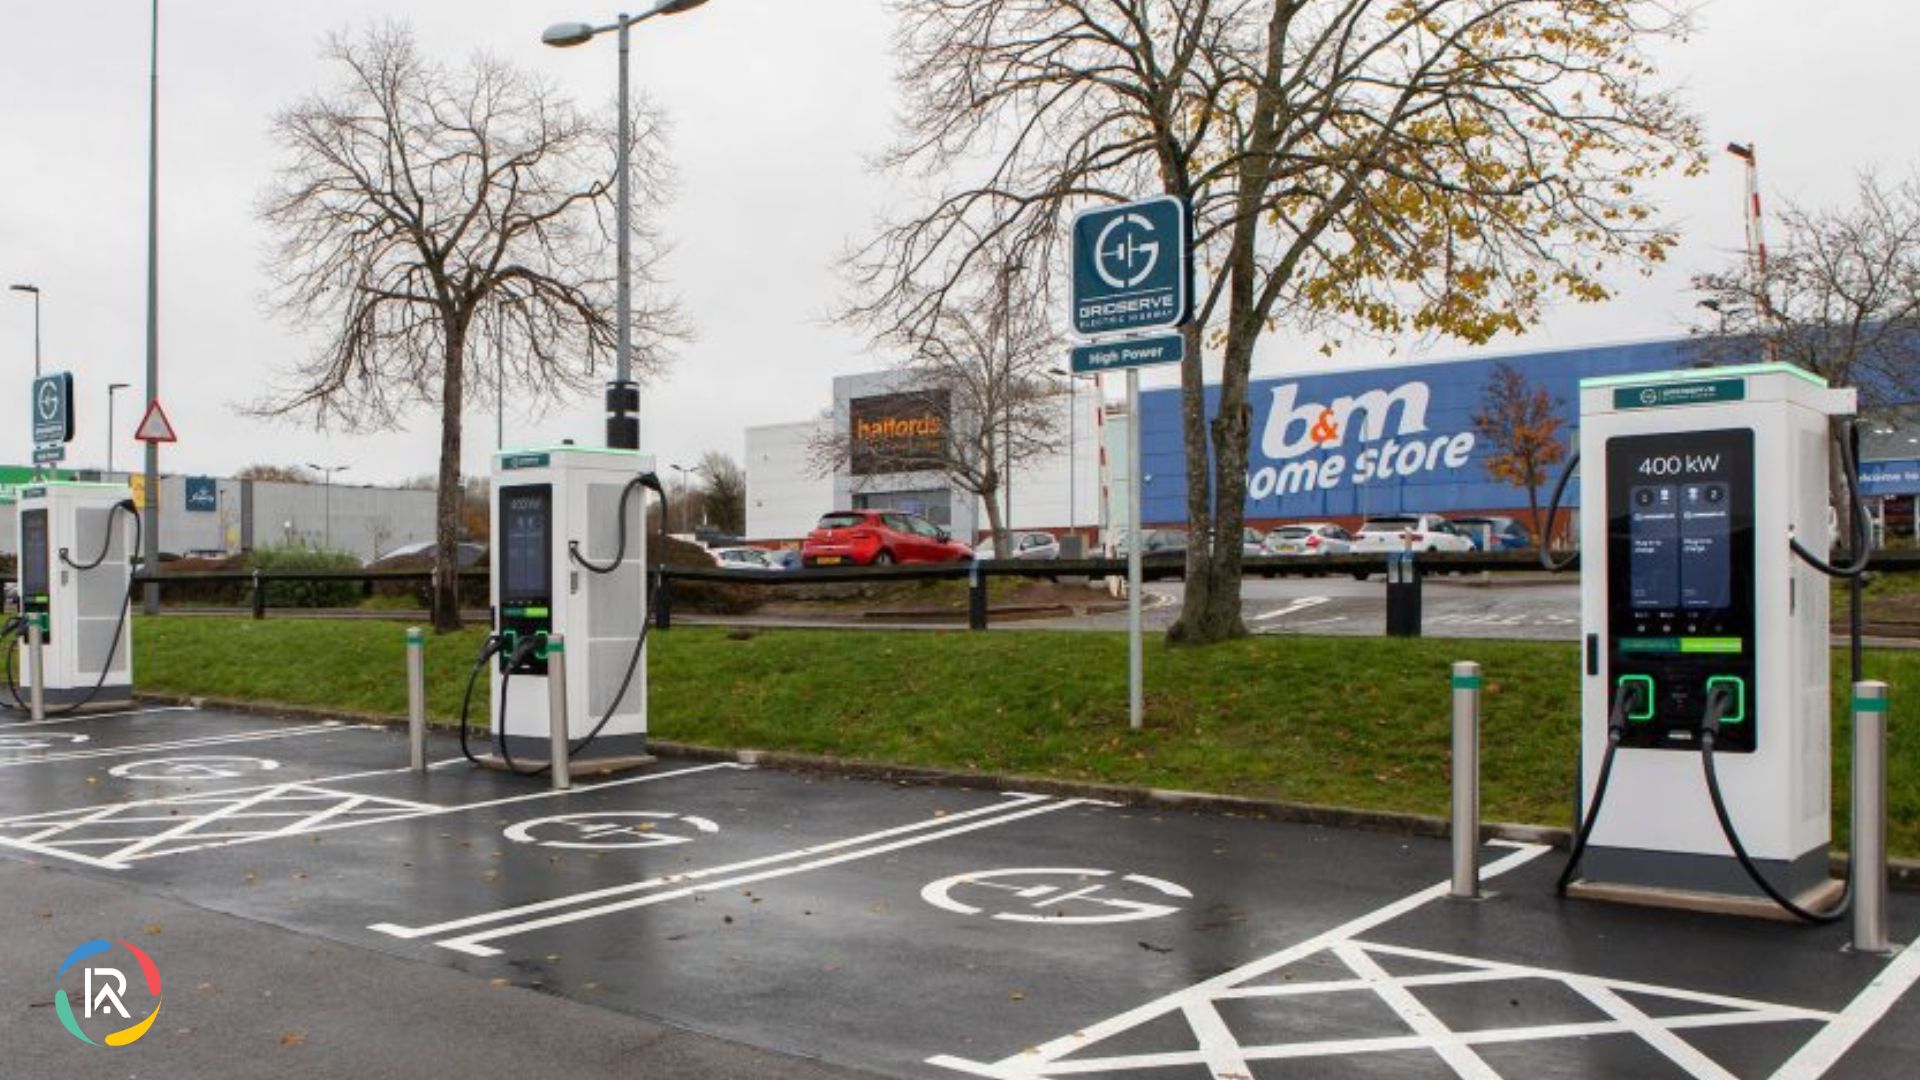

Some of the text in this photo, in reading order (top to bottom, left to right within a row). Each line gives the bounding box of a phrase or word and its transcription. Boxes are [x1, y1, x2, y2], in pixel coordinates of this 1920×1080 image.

[1079, 294, 1174, 318] GRIDSERVE
[1088, 347, 1164, 364] High Power
[1246, 431, 1475, 500] ome store
[1639, 453, 1720, 475] 400 kW
